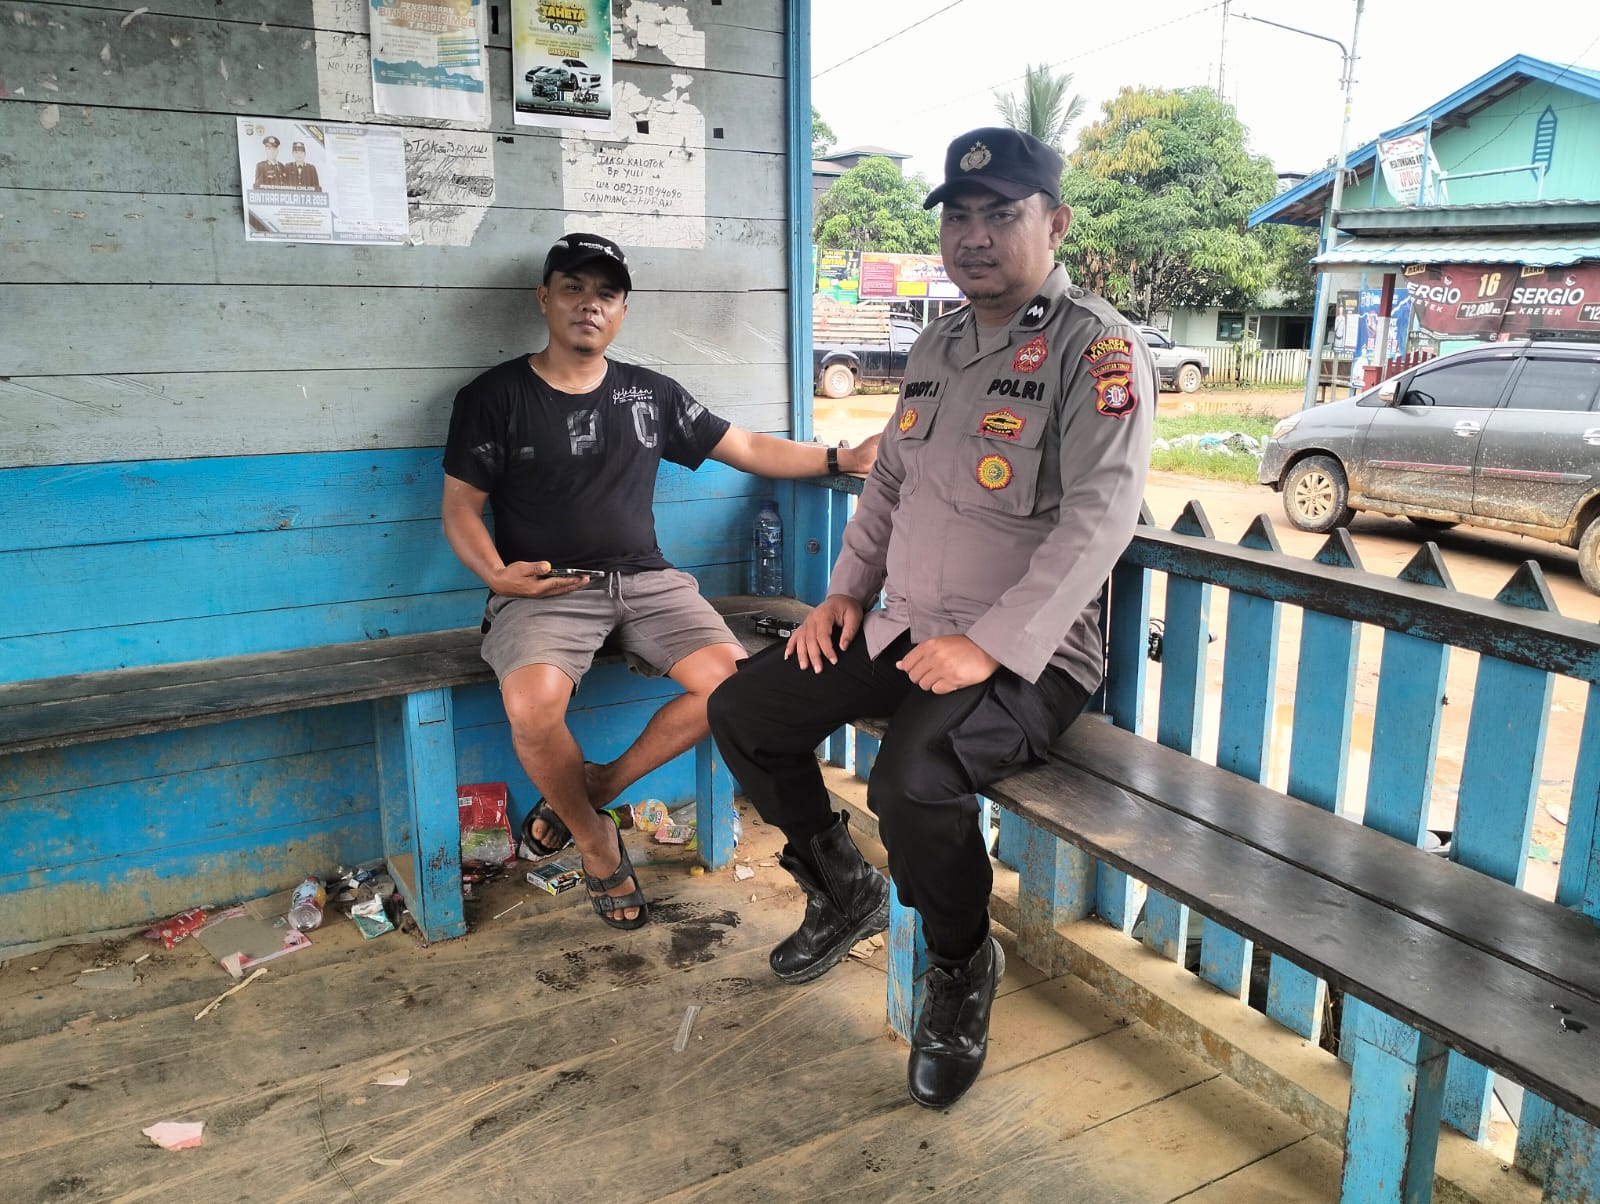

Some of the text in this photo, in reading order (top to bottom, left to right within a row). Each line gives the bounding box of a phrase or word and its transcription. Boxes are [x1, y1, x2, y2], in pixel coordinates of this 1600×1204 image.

[378, 8, 430, 22] BINTARA
[249, 192, 280, 204] BINTARA
[1478, 272, 1502, 297] 16
[1406, 282, 1461, 304] ERGIO
[1511, 287, 1585, 305] SERGIO
[1410, 297, 1444, 313] RETEK
[1519, 307, 1562, 316] KRETEK
[1090, 339, 1125, 352] POLRES
[1090, 344, 1129, 360] KATINGAN
[987, 379, 1045, 401] POLRI
